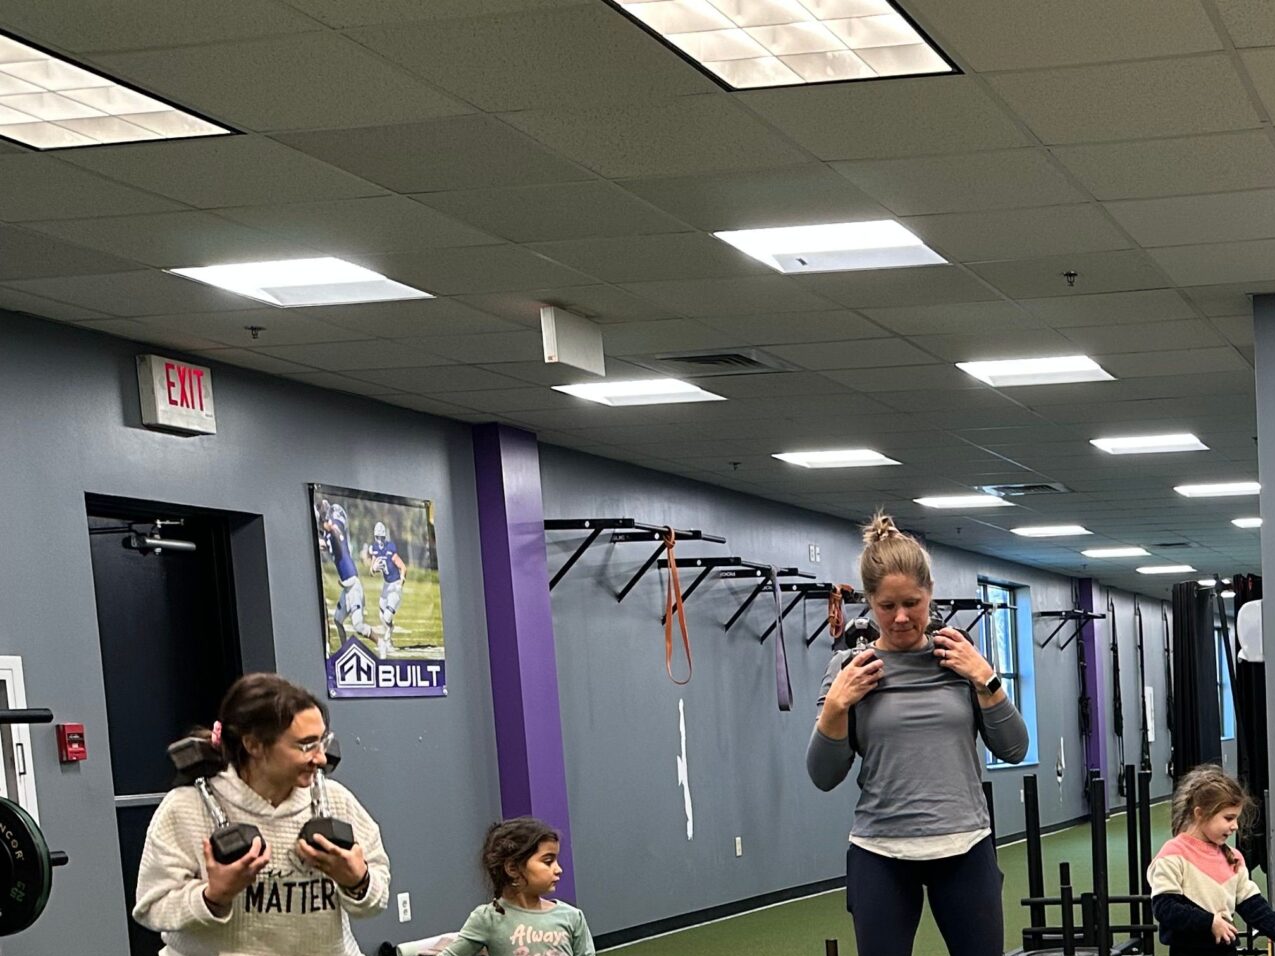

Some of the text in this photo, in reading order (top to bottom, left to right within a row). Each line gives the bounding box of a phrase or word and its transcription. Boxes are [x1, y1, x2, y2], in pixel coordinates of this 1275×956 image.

[165, 362, 204, 411] EXIT
[378, 664, 441, 687] BUILT
[245, 878, 336, 914] MATTER
[509, 923, 570, 946] Always
